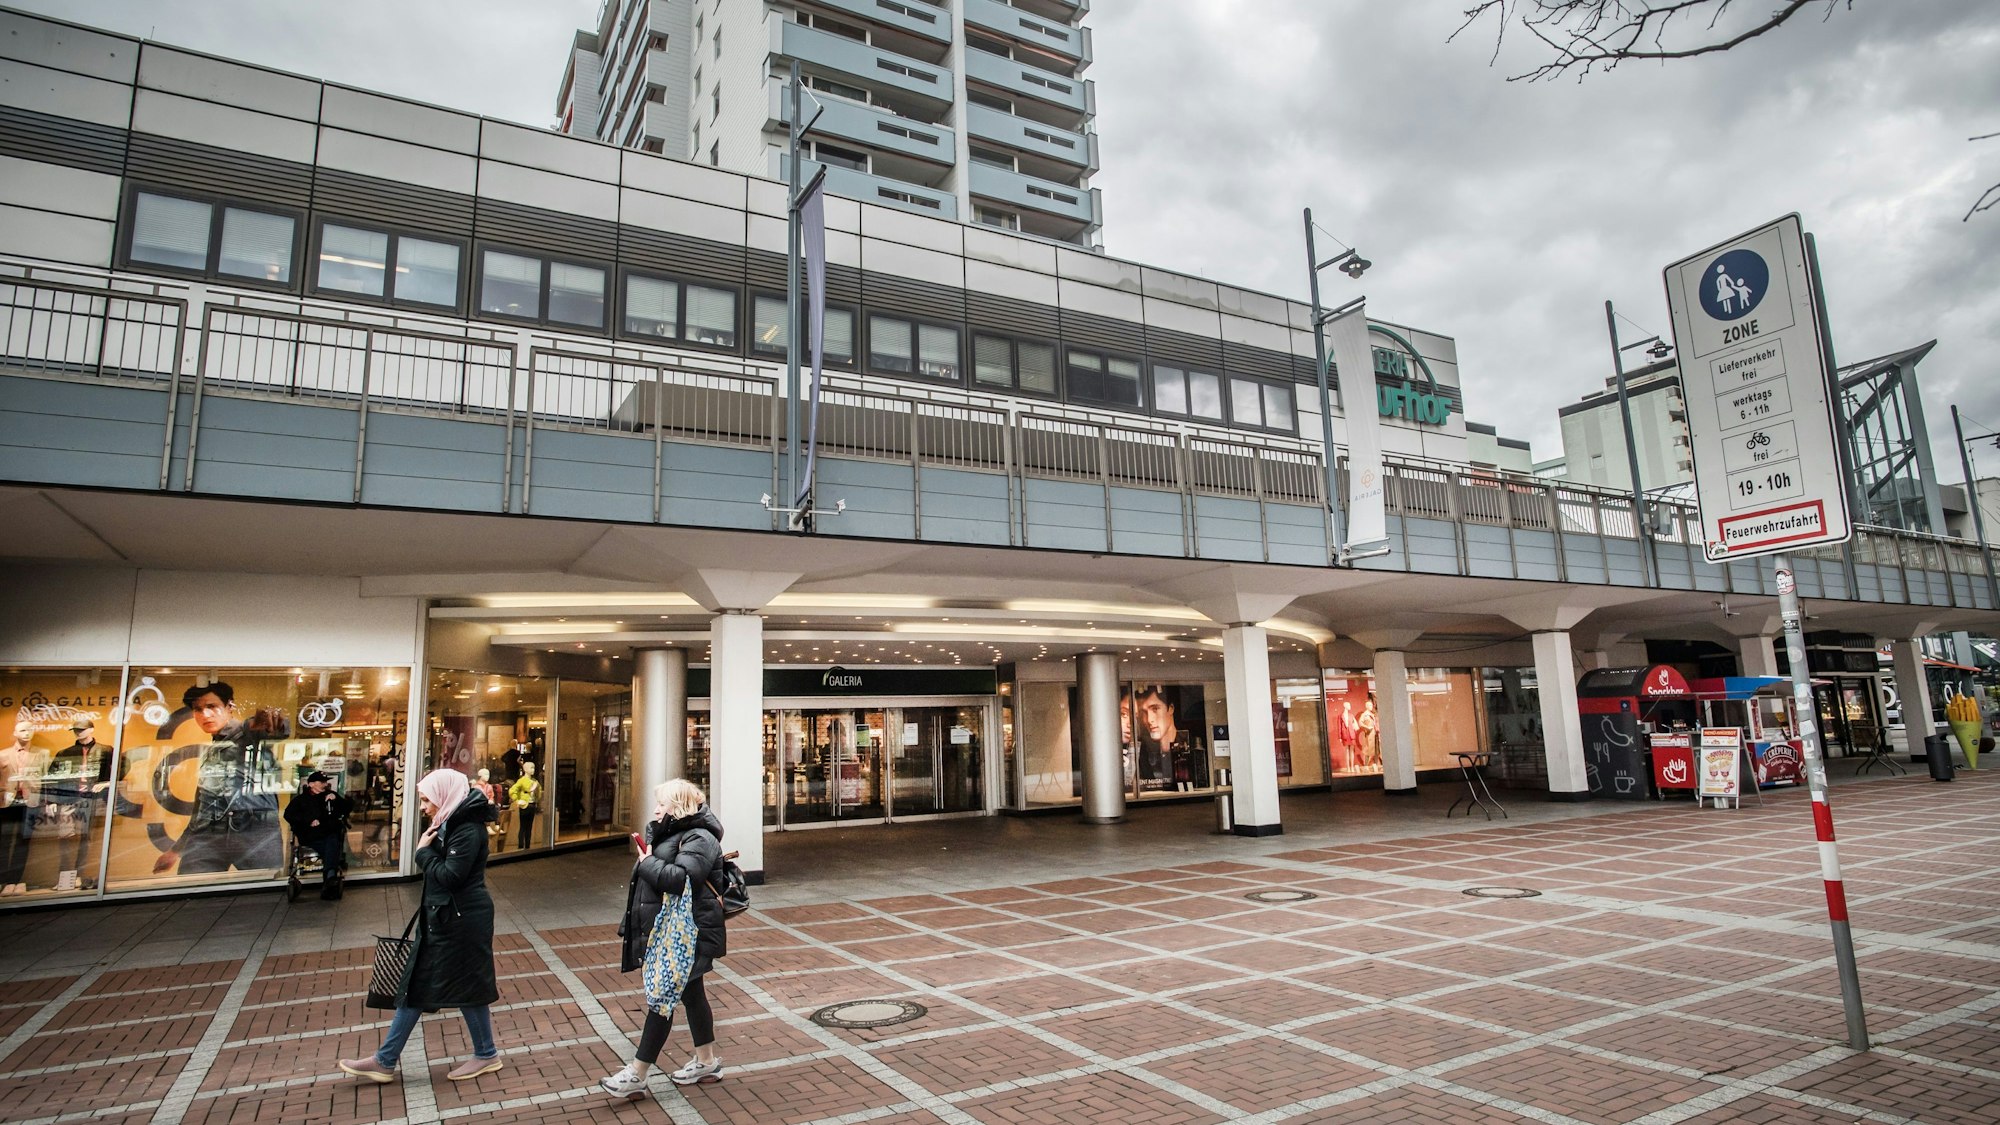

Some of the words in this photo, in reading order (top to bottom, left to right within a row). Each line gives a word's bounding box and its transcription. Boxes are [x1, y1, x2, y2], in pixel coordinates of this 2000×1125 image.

[1722, 319, 1760, 345] ZONE
[1375, 349, 1410, 379] ERIA
[1718, 348, 1776, 375] Lieferverkehr
[1741, 368, 1758, 381] frei
[1732, 389, 1772, 408] werktags
[1740, 411, 1747, 420] 6
[1754, 403, 1770, 416] 11h
[1753, 449, 1770, 462] frei
[1738, 480, 1755, 497] 19
[1766, 472, 1791, 491] 10h
[1725, 512, 1820, 540] Feuerwehrzufahrt
[829, 675, 863, 687] GALERIA
[57, 696, 142, 707] GALERA
[1768, 746, 1793, 759] CRÊPERIE
